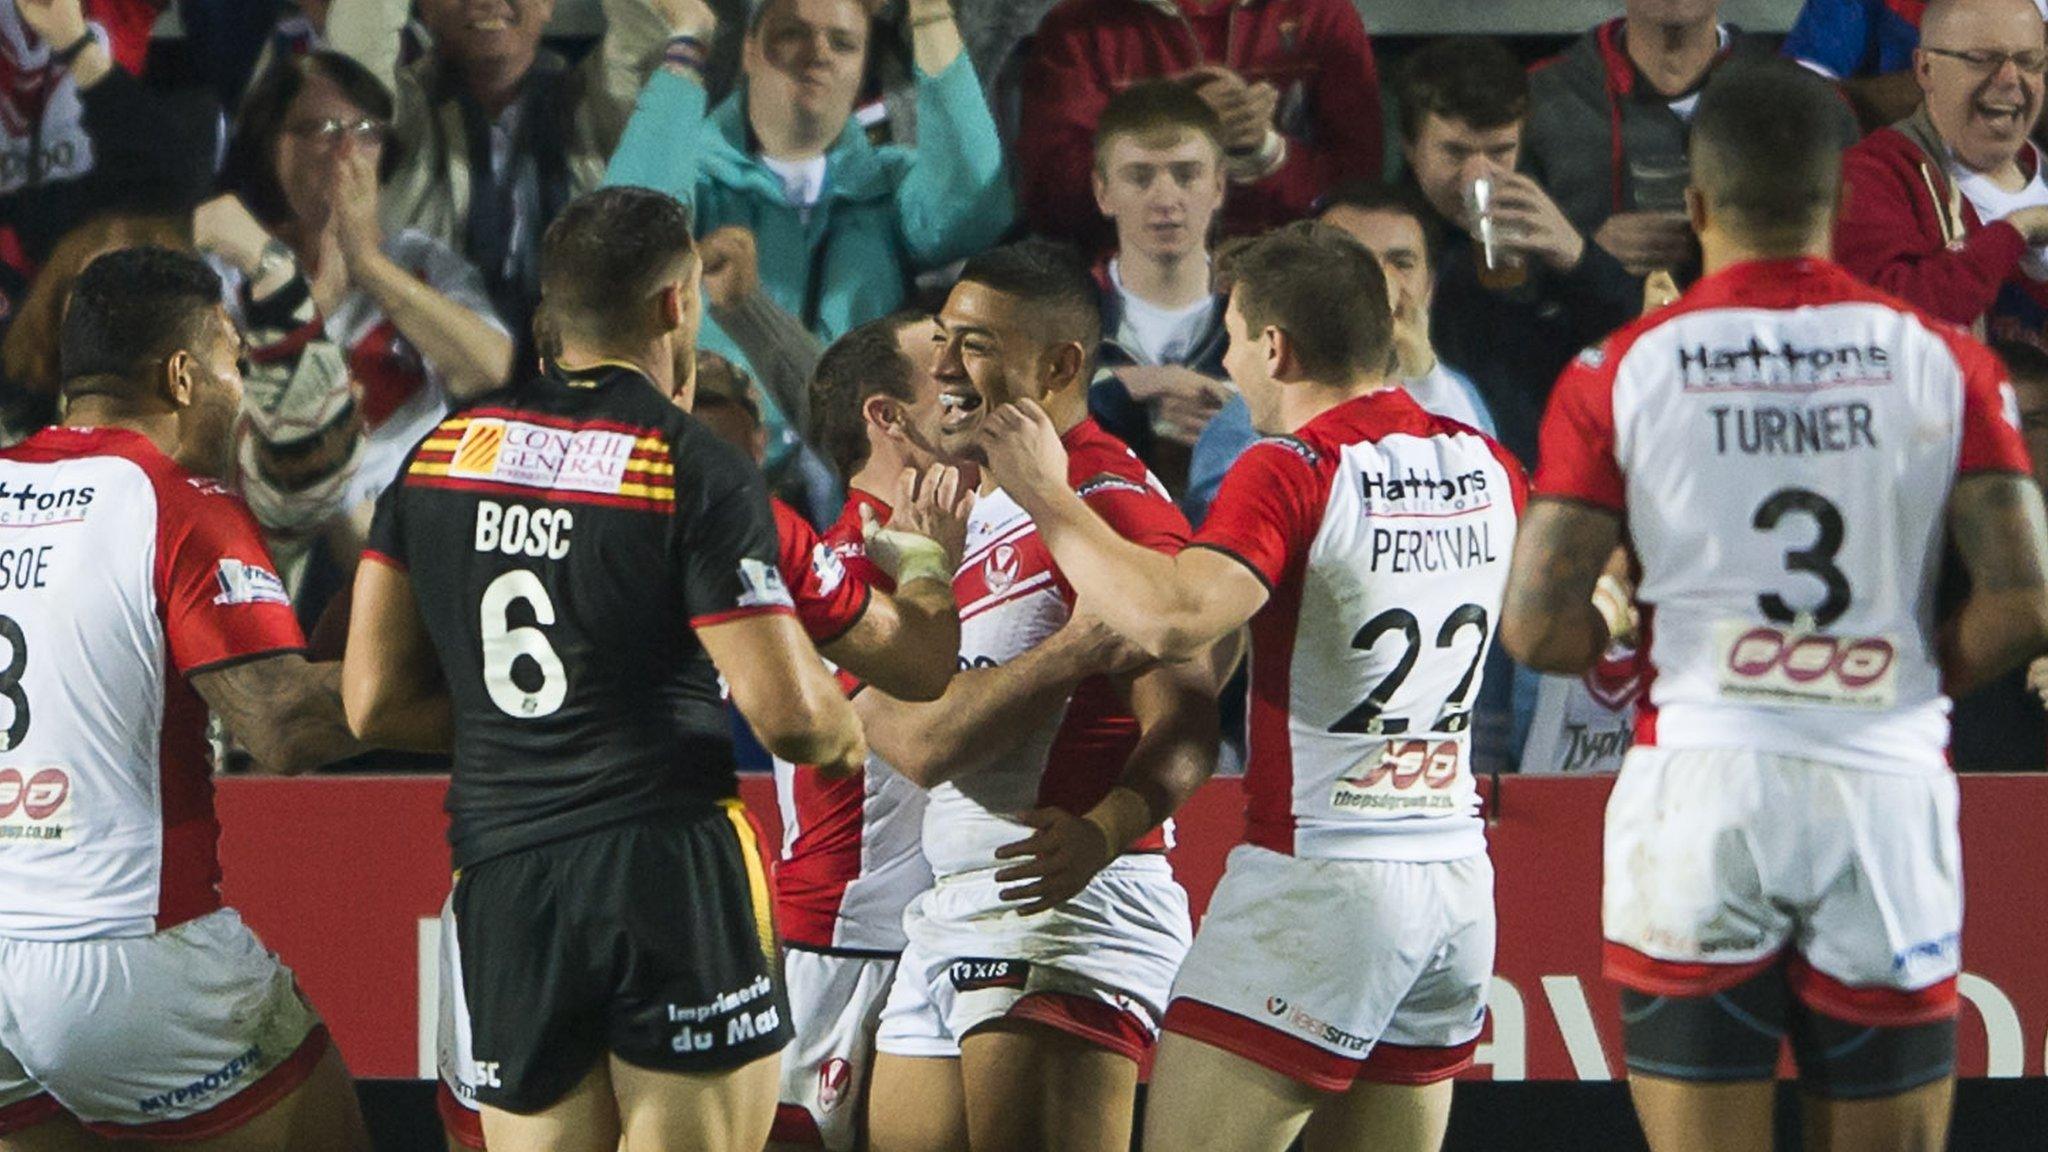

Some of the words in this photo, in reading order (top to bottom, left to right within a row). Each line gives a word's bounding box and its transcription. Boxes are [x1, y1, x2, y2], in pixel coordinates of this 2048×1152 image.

[1708, 402, 1878, 453] TURNER
[474, 500, 574, 560] BOSC
[1370, 520, 1497, 573] PERCIVAL
[1752, 486, 1853, 631] 3
[481, 569, 568, 719] 6
[1328, 603, 1488, 735] 22
[671, 1027, 713, 1052] du
[727, 1005, 779, 1045] Mas
